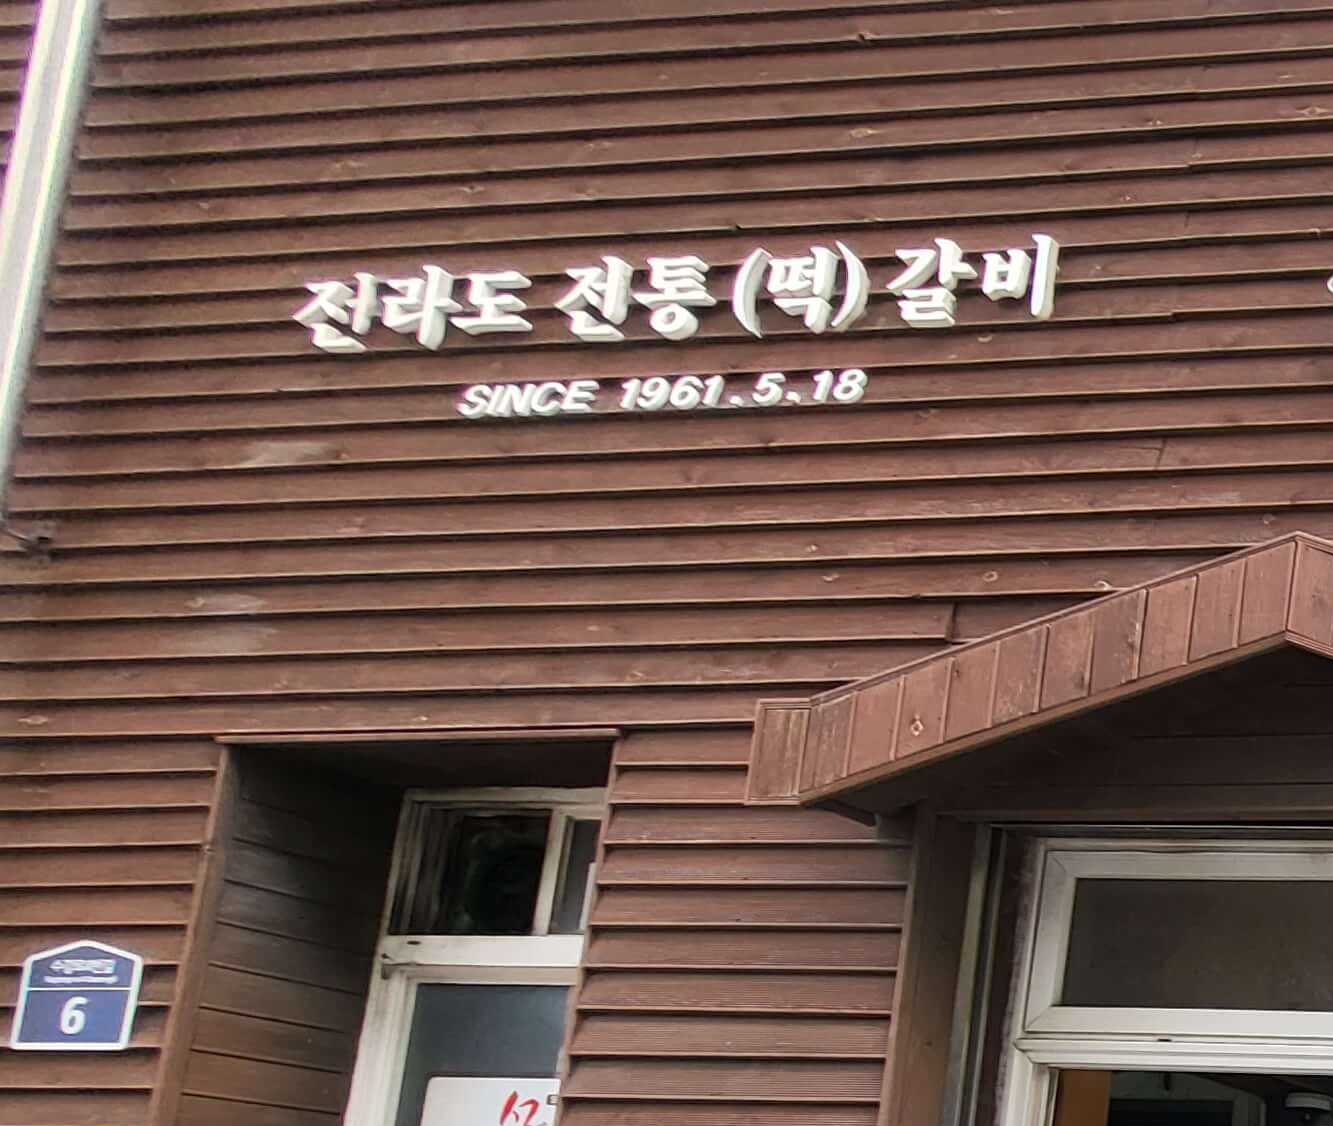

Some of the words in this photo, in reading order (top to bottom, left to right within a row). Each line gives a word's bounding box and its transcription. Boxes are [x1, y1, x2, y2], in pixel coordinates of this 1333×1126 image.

[293, 265, 533, 353] 전라도
[556, 255, 717, 342] 전통
[457, 379, 600, 419] SINCE
[618, 369, 869, 412] 1961.5.18
[60, 996, 89, 1034] 6
